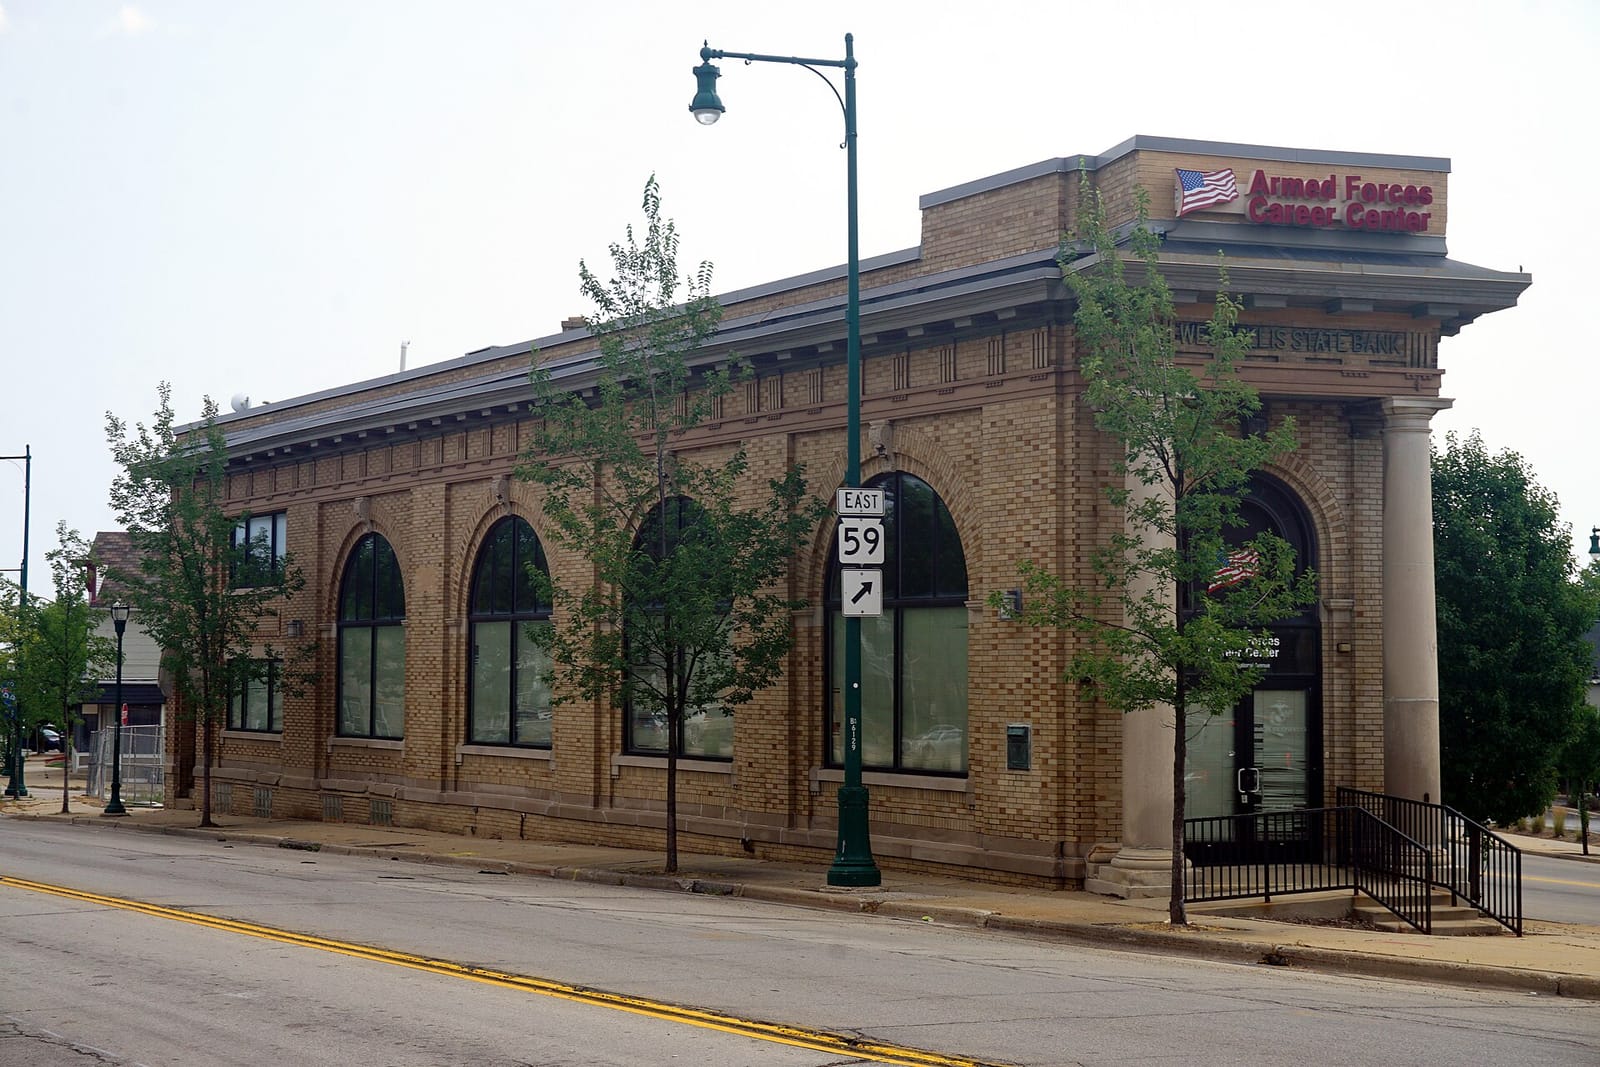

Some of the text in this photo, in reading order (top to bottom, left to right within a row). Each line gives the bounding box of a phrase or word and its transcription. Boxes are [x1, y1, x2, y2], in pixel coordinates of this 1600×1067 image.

[1249, 169, 1433, 206] Armed Forces
[1248, 195, 1431, 233] Career Center
[1291, 329, 1348, 353] STATE
[1351, 331, 1401, 355] BANK
[845, 492, 878, 509] EAST
[844, 527, 879, 556] 59
